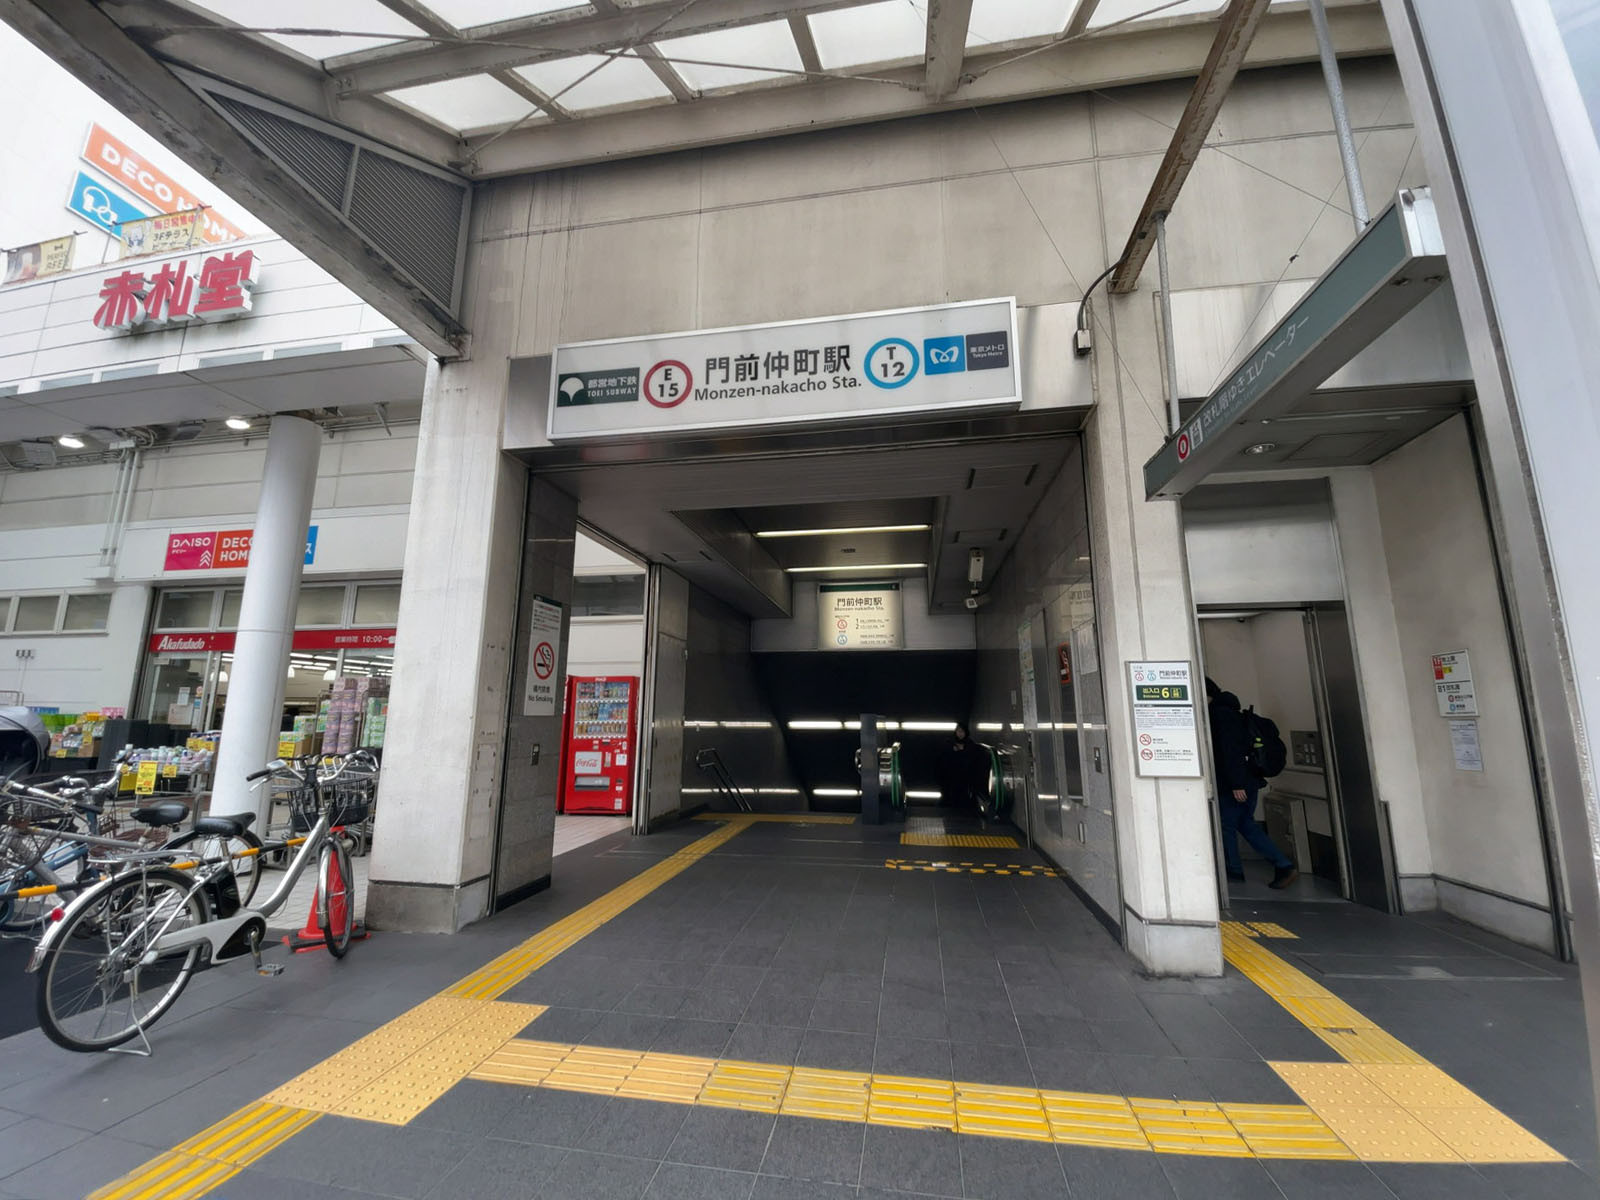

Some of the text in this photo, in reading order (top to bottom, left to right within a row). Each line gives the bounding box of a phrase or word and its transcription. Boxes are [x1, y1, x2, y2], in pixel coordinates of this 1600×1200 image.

[102, 143, 173, 203] DECO
[93, 250, 256, 328] 赤札堂
[886, 346, 897, 360] T
[970, 344, 1005, 354] 東京メトロ
[705, 344, 851, 385] 門前仲町駅
[881, 361, 905, 378] 12
[664, 368, 672, 381] E
[1202, 316, 1310, 428] 改札階ゆきエレベーター
[587, 376, 637, 389] 都営地下鉄
[694, 375, 862, 401] Monzen-nakacho Sta.
[587, 387, 637, 398] TOEI SUBWAY
[658, 383, 679, 398] 15
[172, 537, 212, 549] DAISO
[219, 551, 249, 562] HOM
[837, 597, 883, 606] 門前仲町駅
[1161, 687, 1170, 698] 6
